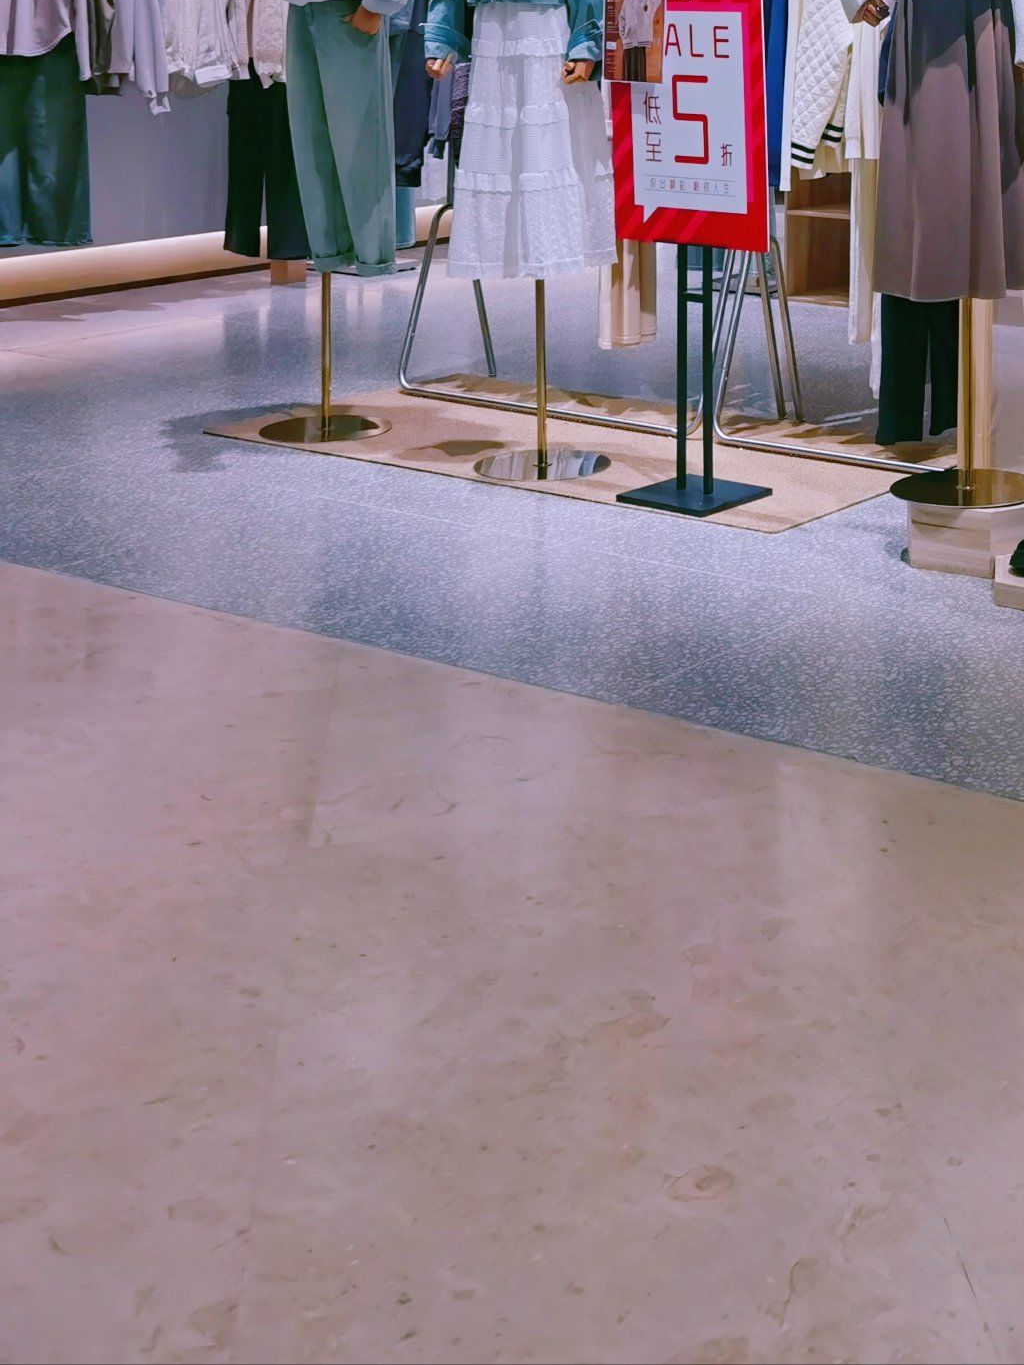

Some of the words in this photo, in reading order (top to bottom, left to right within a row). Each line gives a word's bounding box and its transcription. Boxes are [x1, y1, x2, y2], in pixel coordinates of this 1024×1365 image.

[664, 23, 730, 59] ALE
[642, 91, 662, 163] 低至
[671, 74, 709, 165] 5
[720, 142, 733, 167] 折
